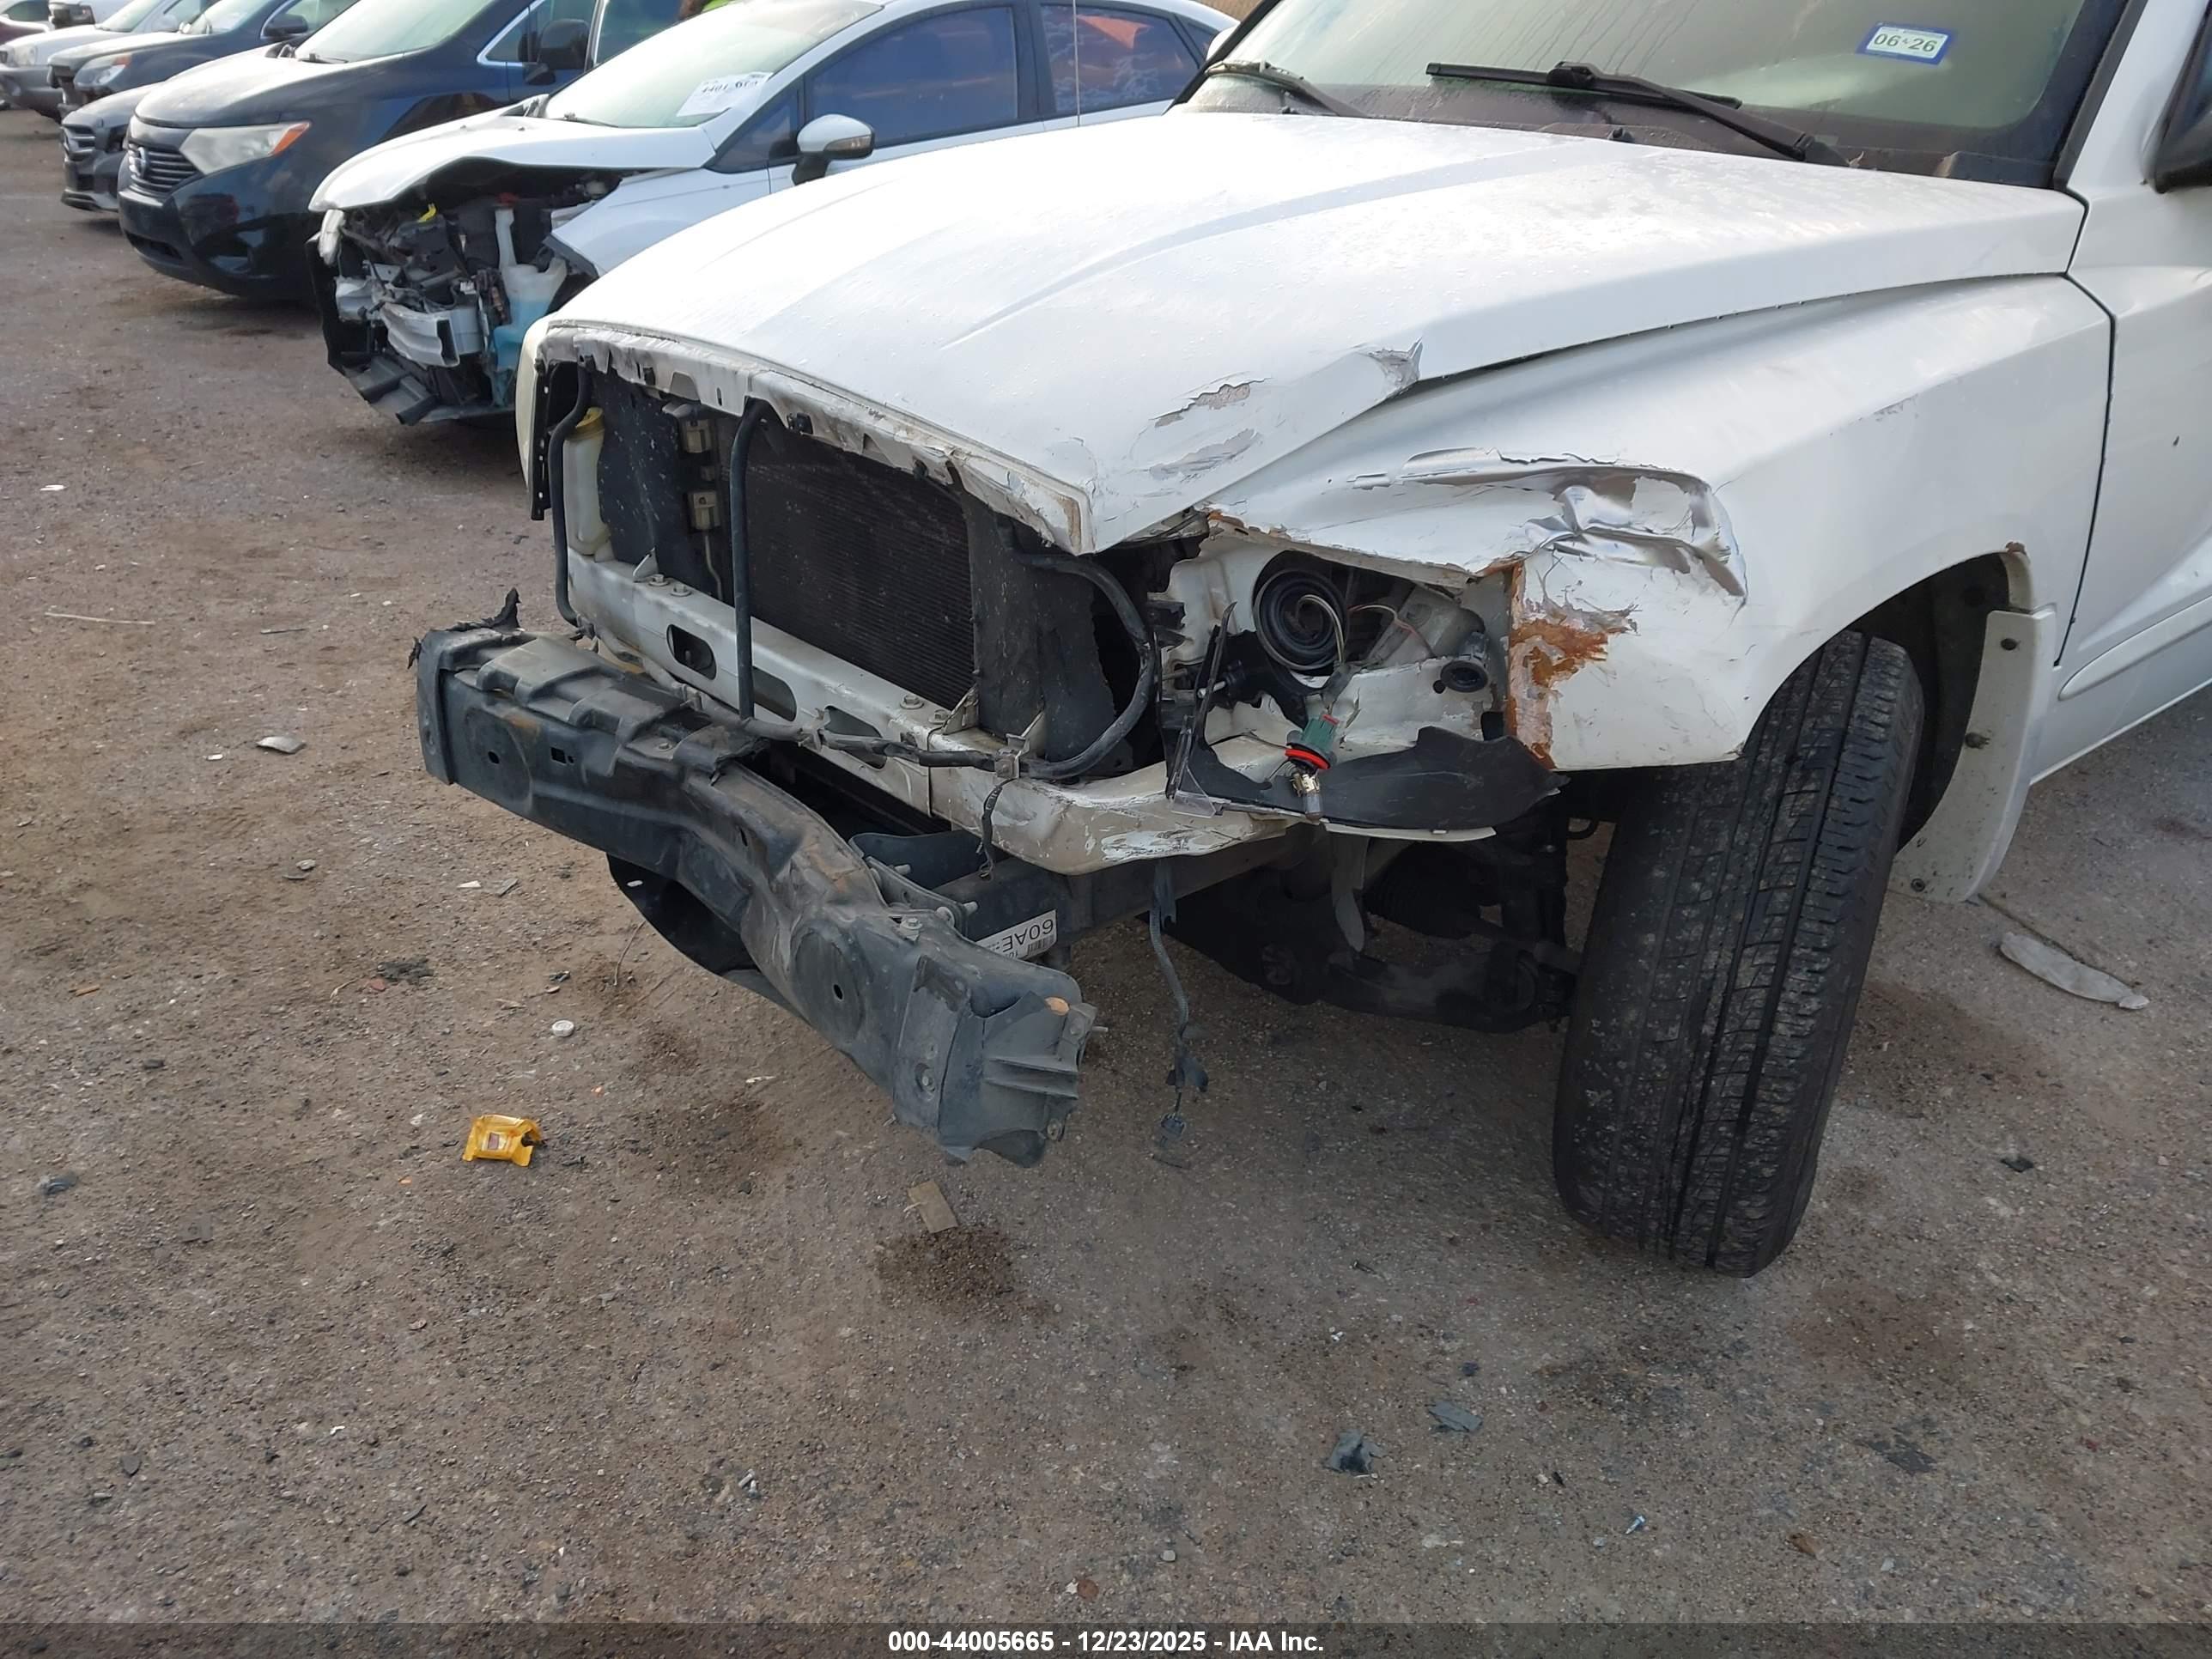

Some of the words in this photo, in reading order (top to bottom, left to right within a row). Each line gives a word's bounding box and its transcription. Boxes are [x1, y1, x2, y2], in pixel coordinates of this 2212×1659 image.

[1873, 33, 1900, 47] 06
[1907, 37, 1938, 52] 26
[1001, 919, 1054, 953] 60AE
